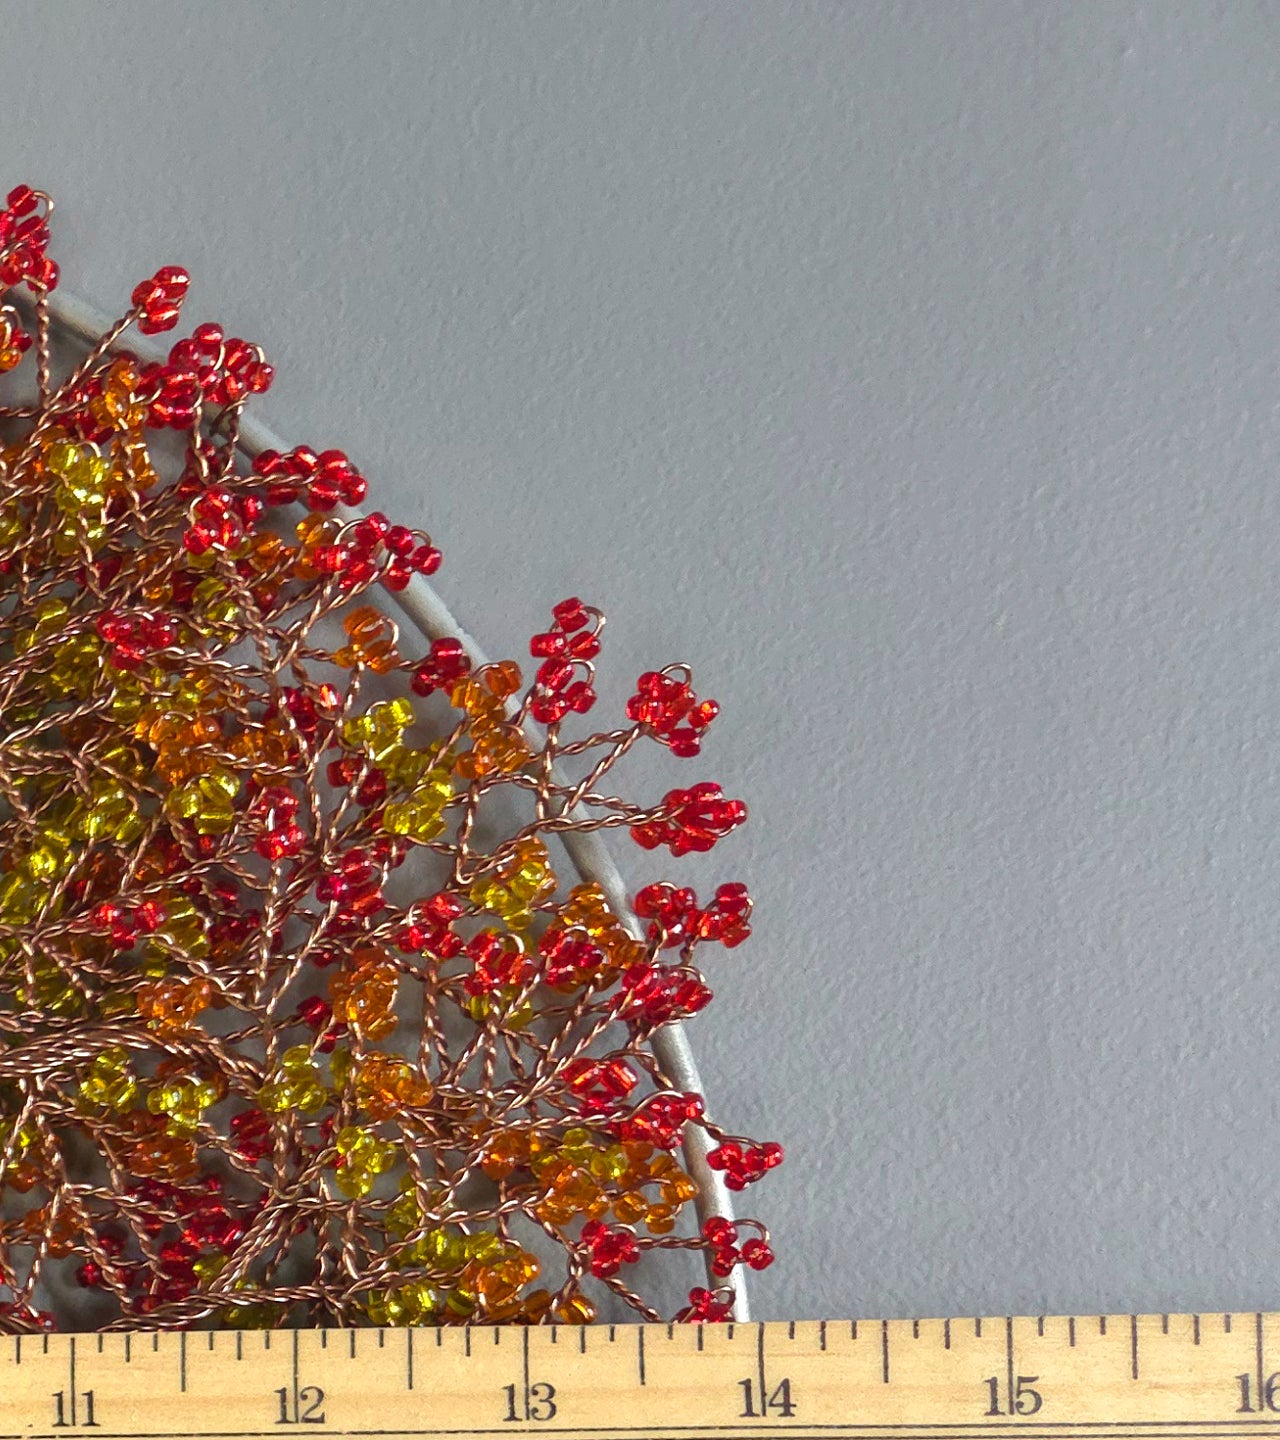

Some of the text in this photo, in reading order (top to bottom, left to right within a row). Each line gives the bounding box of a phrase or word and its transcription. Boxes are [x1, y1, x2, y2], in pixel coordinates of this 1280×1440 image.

[51, 1391, 101, 1427] 11
[274, 1387, 326, 1424] 12
[502, 1383, 556, 1422] 13
[739, 1378, 797, 1417] 14
[984, 1376, 1042, 1416] 15
